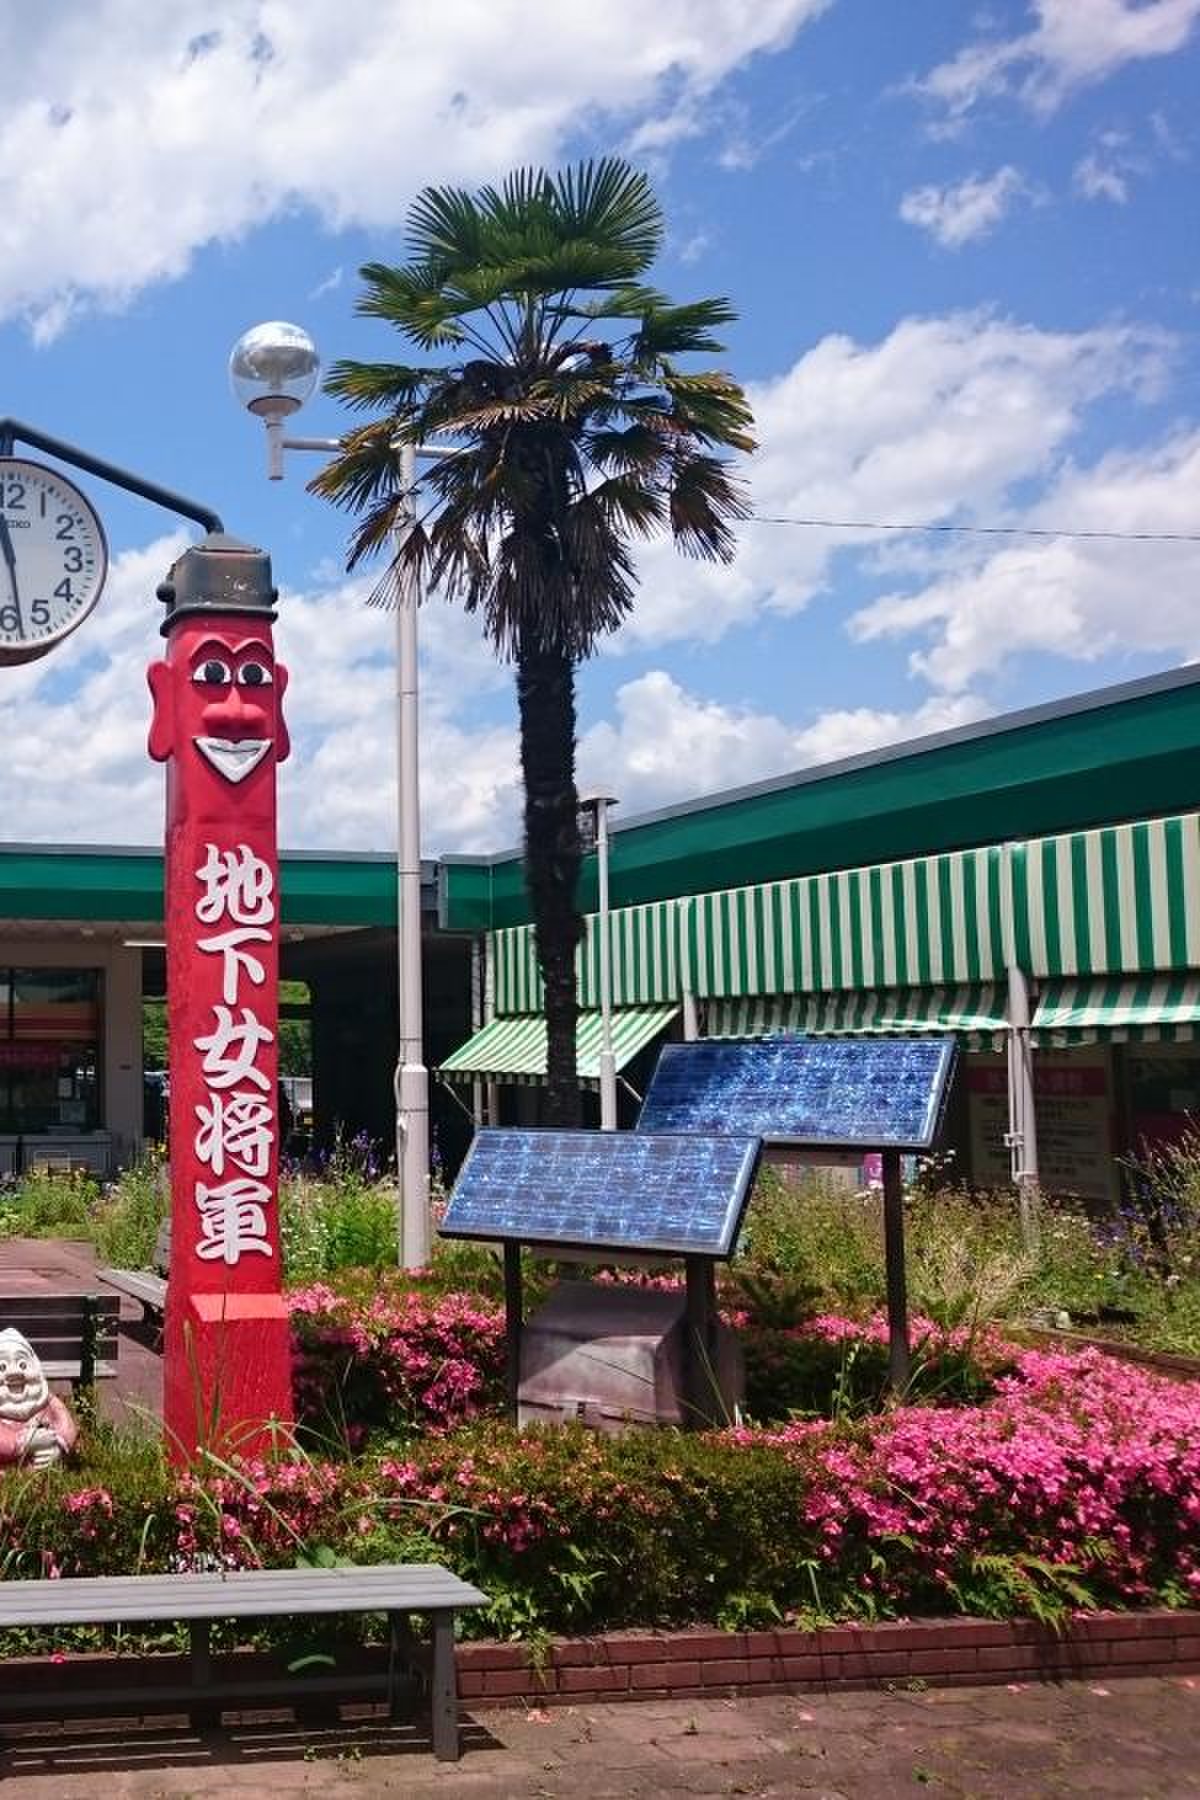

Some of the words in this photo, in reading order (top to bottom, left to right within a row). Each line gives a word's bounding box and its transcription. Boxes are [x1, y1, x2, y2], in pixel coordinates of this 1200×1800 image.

[0, 482, 26, 509] 12
[56, 514, 75, 541] 2
[64, 547, 83, 573] 3
[54, 577, 74, 602] 4
[0, 606, 19, 632] 6
[31, 600, 49, 625] 5
[194, 844, 274, 1265] 地下女将軍
